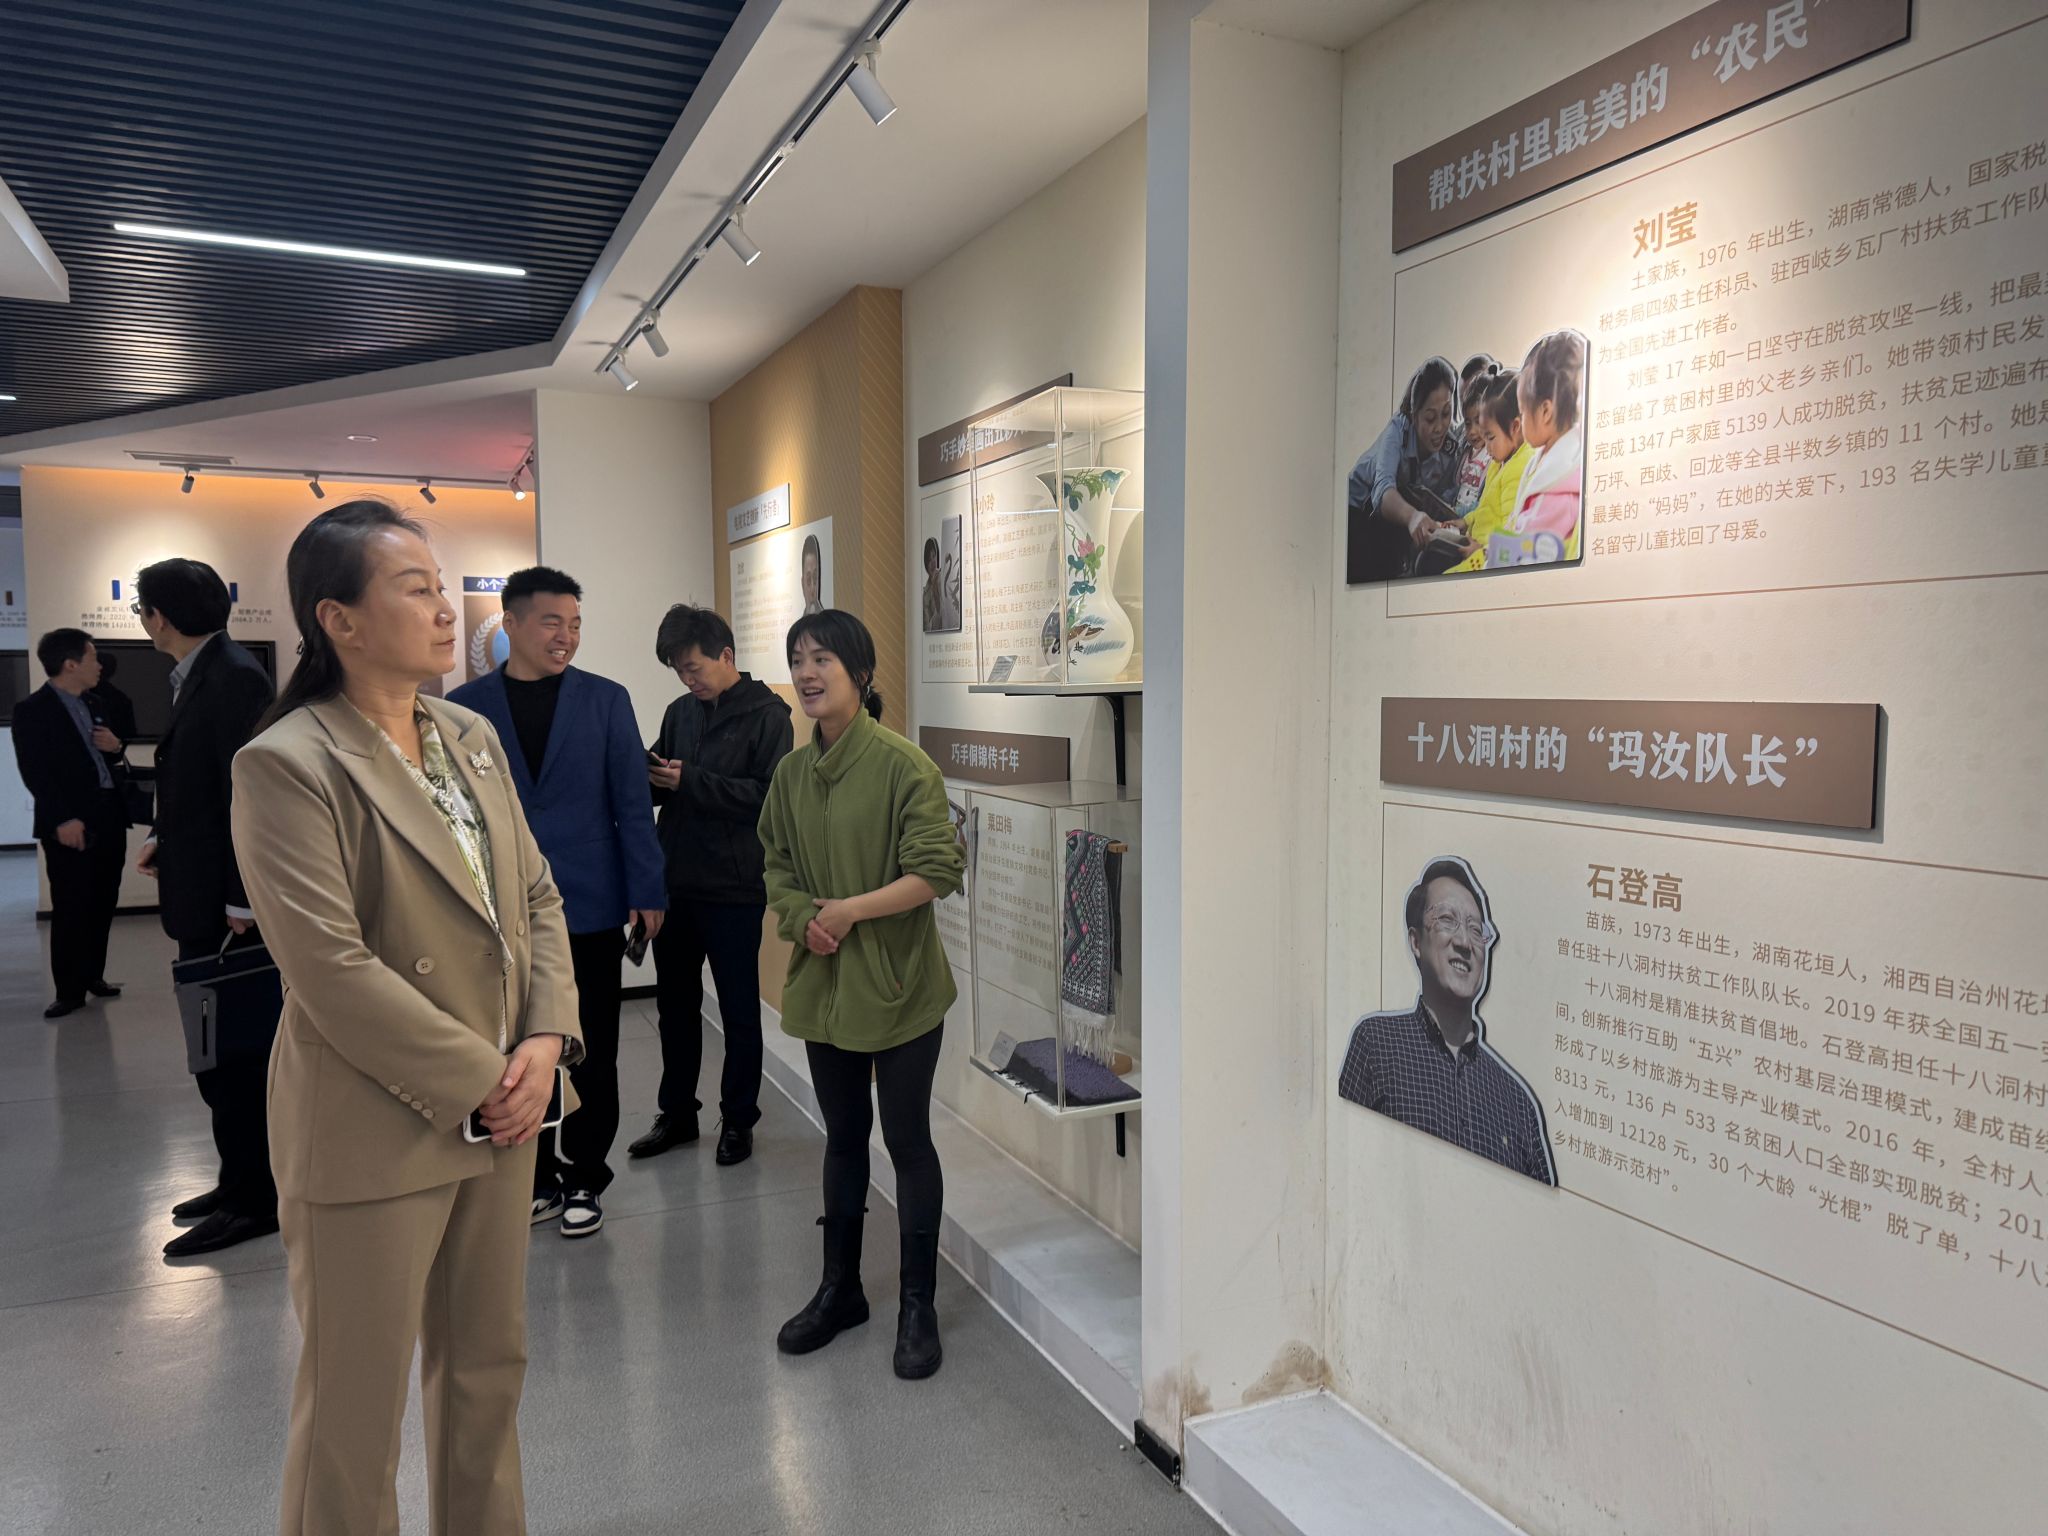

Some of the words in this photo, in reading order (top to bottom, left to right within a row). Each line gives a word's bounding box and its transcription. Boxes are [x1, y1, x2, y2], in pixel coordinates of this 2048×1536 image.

[1633, 202, 1698, 259] 刘莹
[1597, 312, 1737, 365] 为全国先进工作者。
[1910, 443, 2048, 483] 名失学儿童
[1591, 518, 1767, 556] 名留守儿童找回了母爱。
[951, 743, 1019, 773] 巧手侗锦传千年
[1407, 721, 1818, 788] 十八洞村的“玛汝队长”
[1586, 863, 1683, 912] 石登高
[1883, 1007, 2048, 1064] 年获全国五一
[1554, 1130, 1679, 1193] 乡村旅游示范村”。
